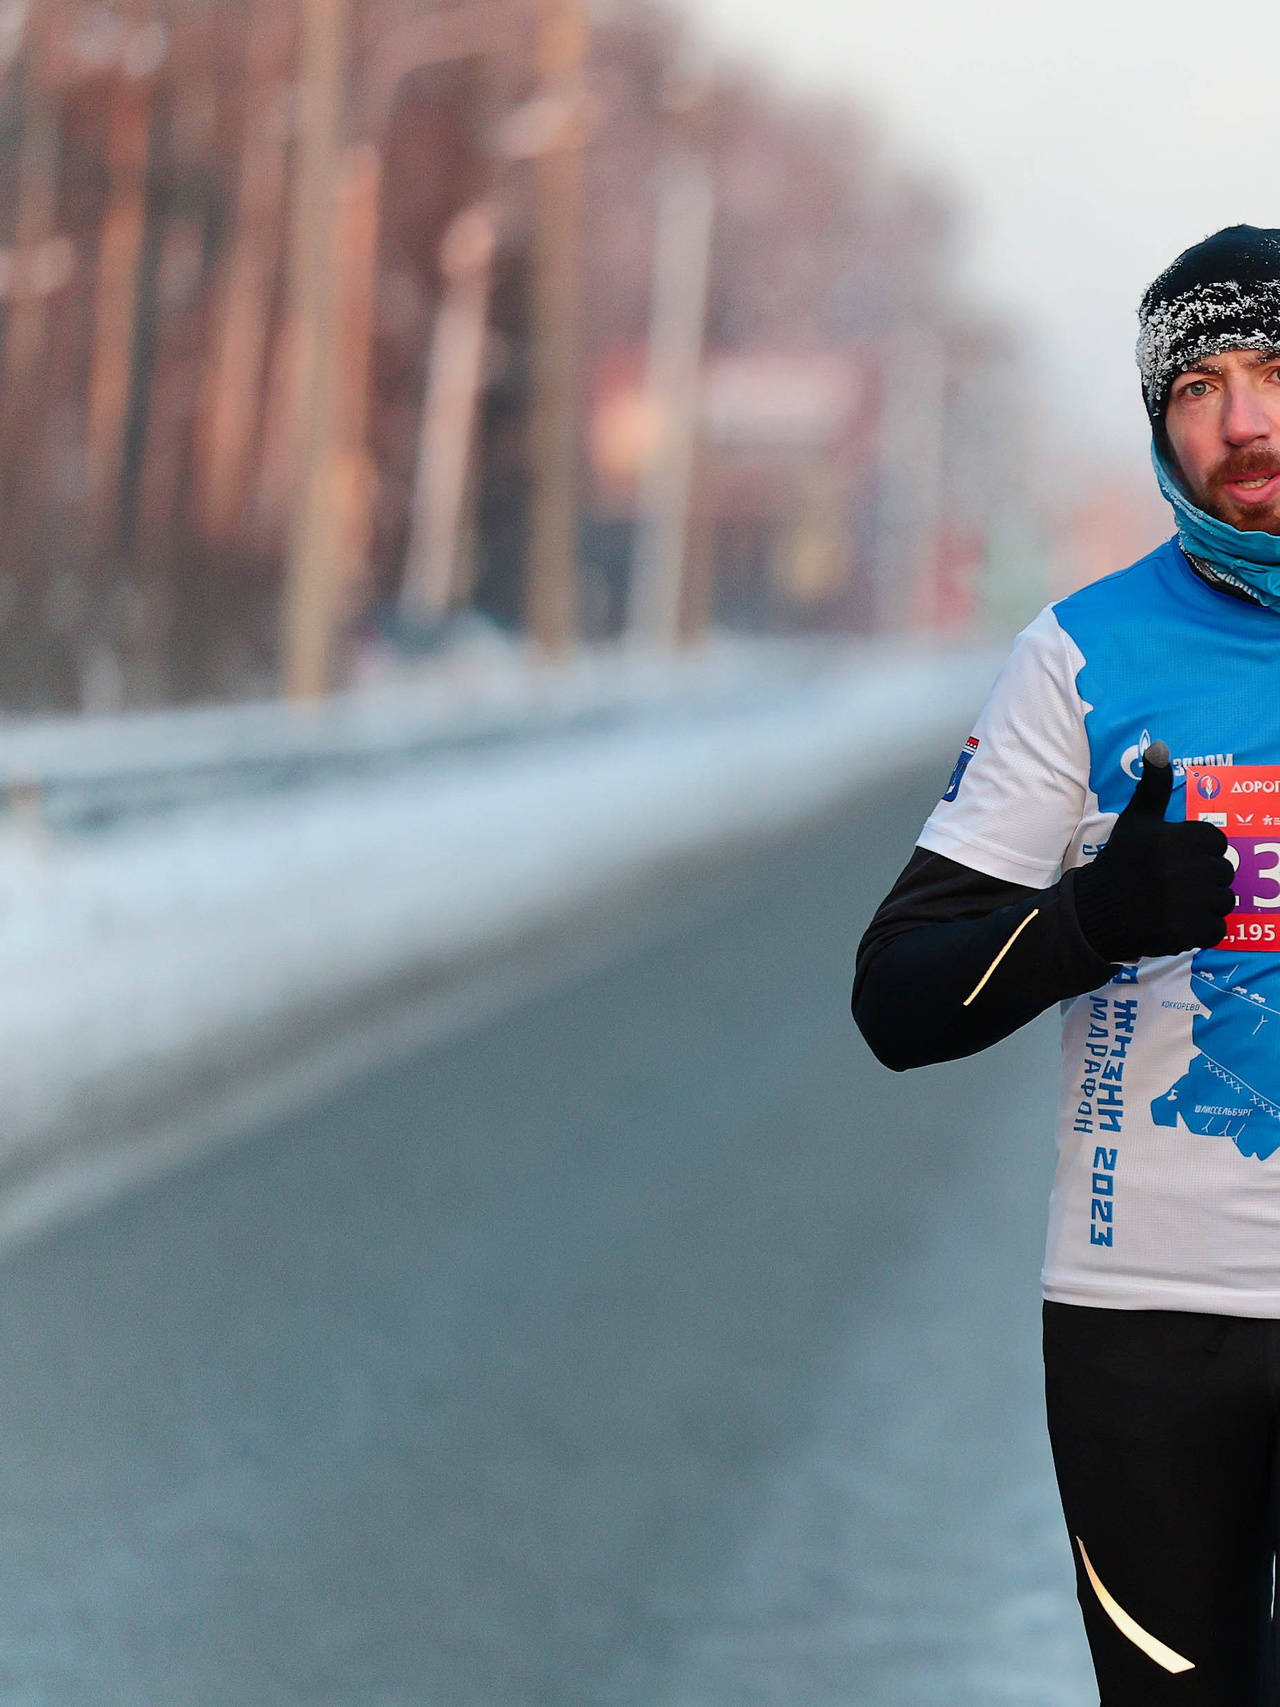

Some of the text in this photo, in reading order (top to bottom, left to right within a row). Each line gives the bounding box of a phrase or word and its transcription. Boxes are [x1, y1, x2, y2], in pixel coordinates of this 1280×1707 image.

[1223, 923, 1276, 943] ,195
[1073, 995, 1109, 1134] МАРАФОН
[1097, 999, 1139, 1132] ЖИЗНИ
[1194, 1104, 1254, 1117] ШЛИССЕЛЬБУРГ
[1090, 1146, 1119, 1248] 2023
